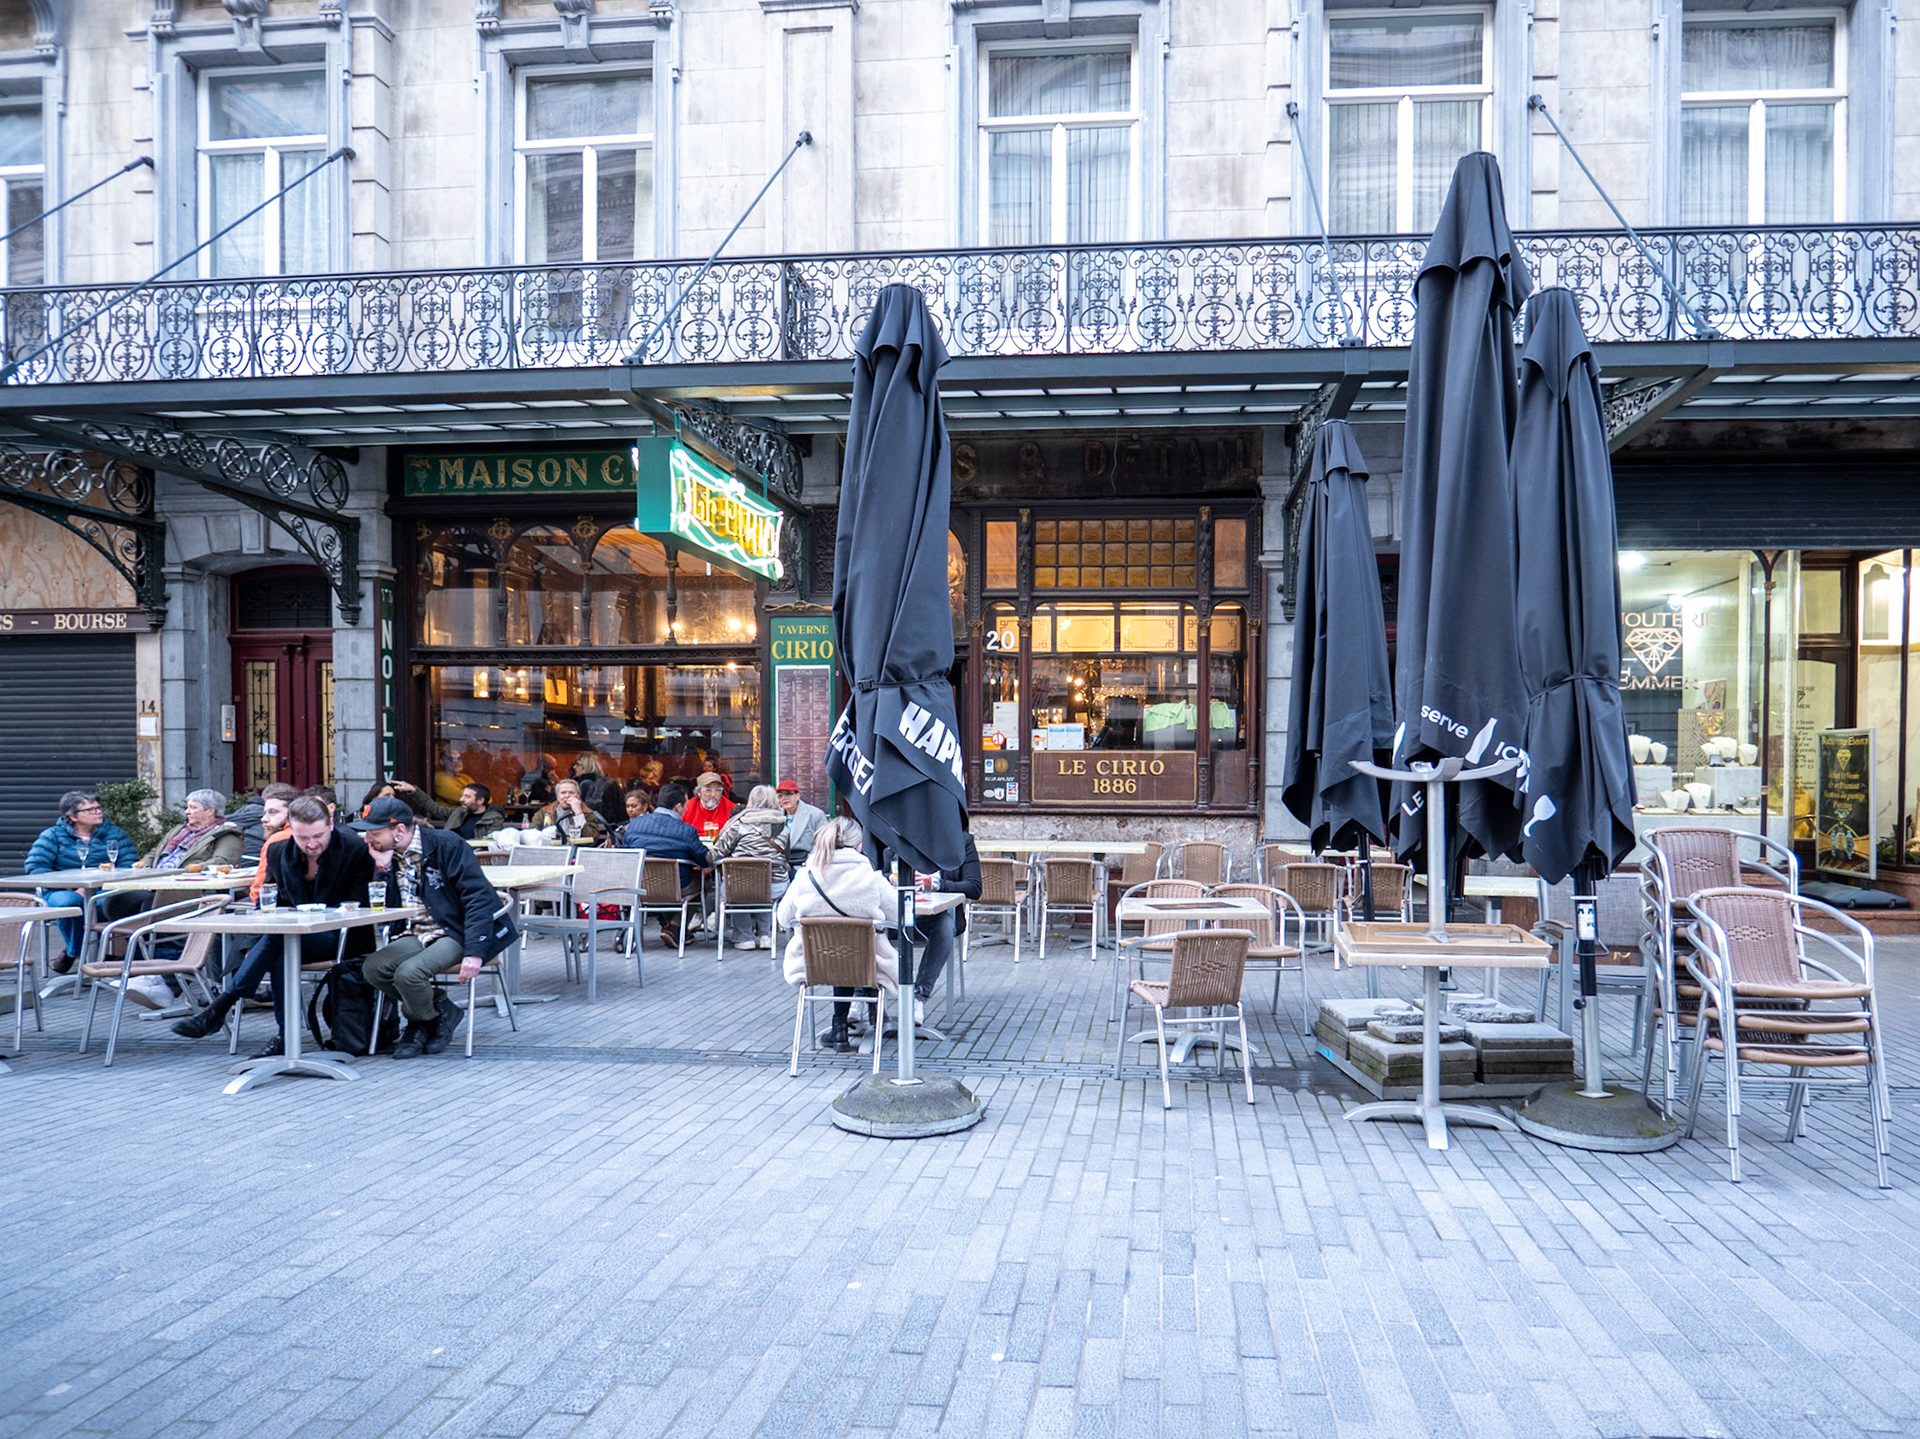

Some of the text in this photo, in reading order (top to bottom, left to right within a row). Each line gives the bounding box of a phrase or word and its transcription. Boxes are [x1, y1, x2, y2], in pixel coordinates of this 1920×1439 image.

[438, 454, 638, 489] MAISON C
[53, 613, 127, 631] BOURSE
[778, 625, 829, 635] TAVERNE
[771, 640, 834, 659] CIRIO
[986, 631, 1016, 650] 20
[141, 700, 156, 713] 14
[1420, 705, 1470, 739] serve
[1057, 760, 1165, 775] LE CIRIO
[1092, 778, 1138, 794] 1886
[1402, 790, 1425, 816] LE
